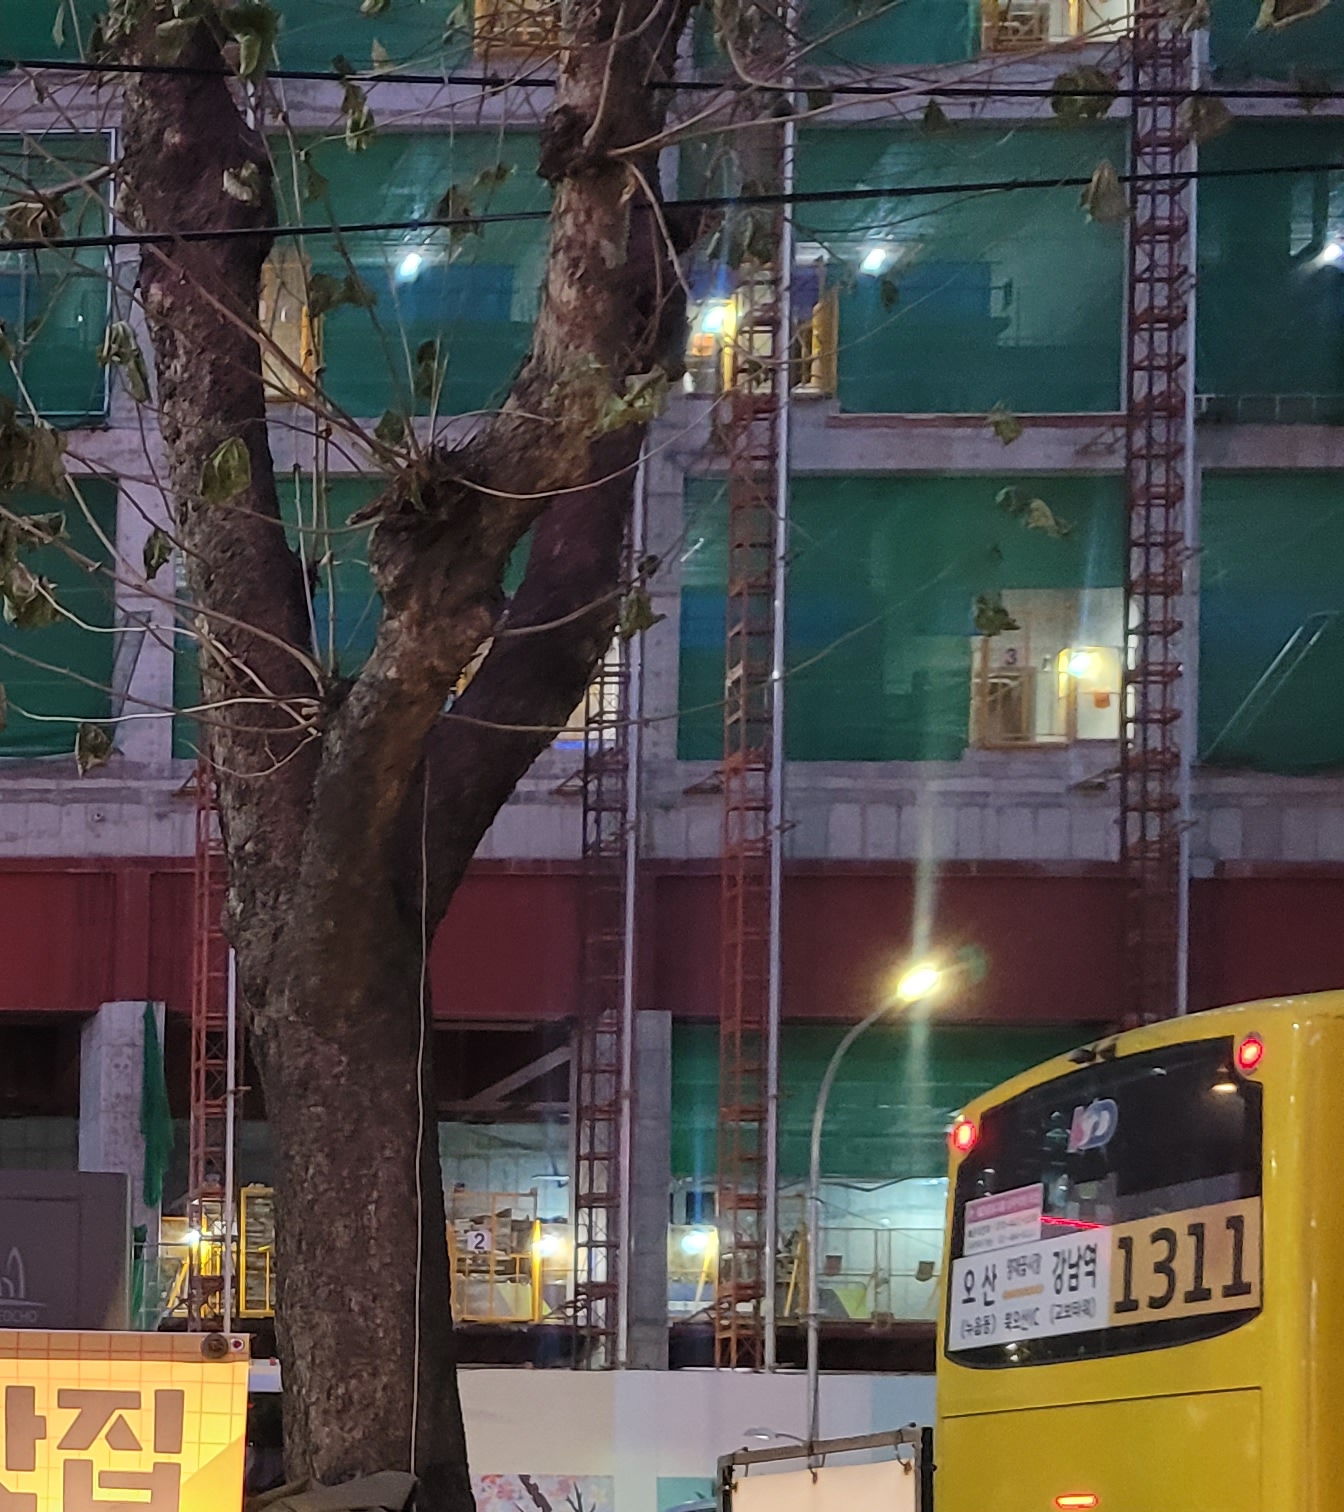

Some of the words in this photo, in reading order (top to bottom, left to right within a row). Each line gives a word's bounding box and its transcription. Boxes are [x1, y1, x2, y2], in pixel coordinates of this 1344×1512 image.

[474, 1232, 485, 1250] 2
[1114, 1214, 1252, 1314] 1311
[1052, 1243, 1097, 1295] 강남역
